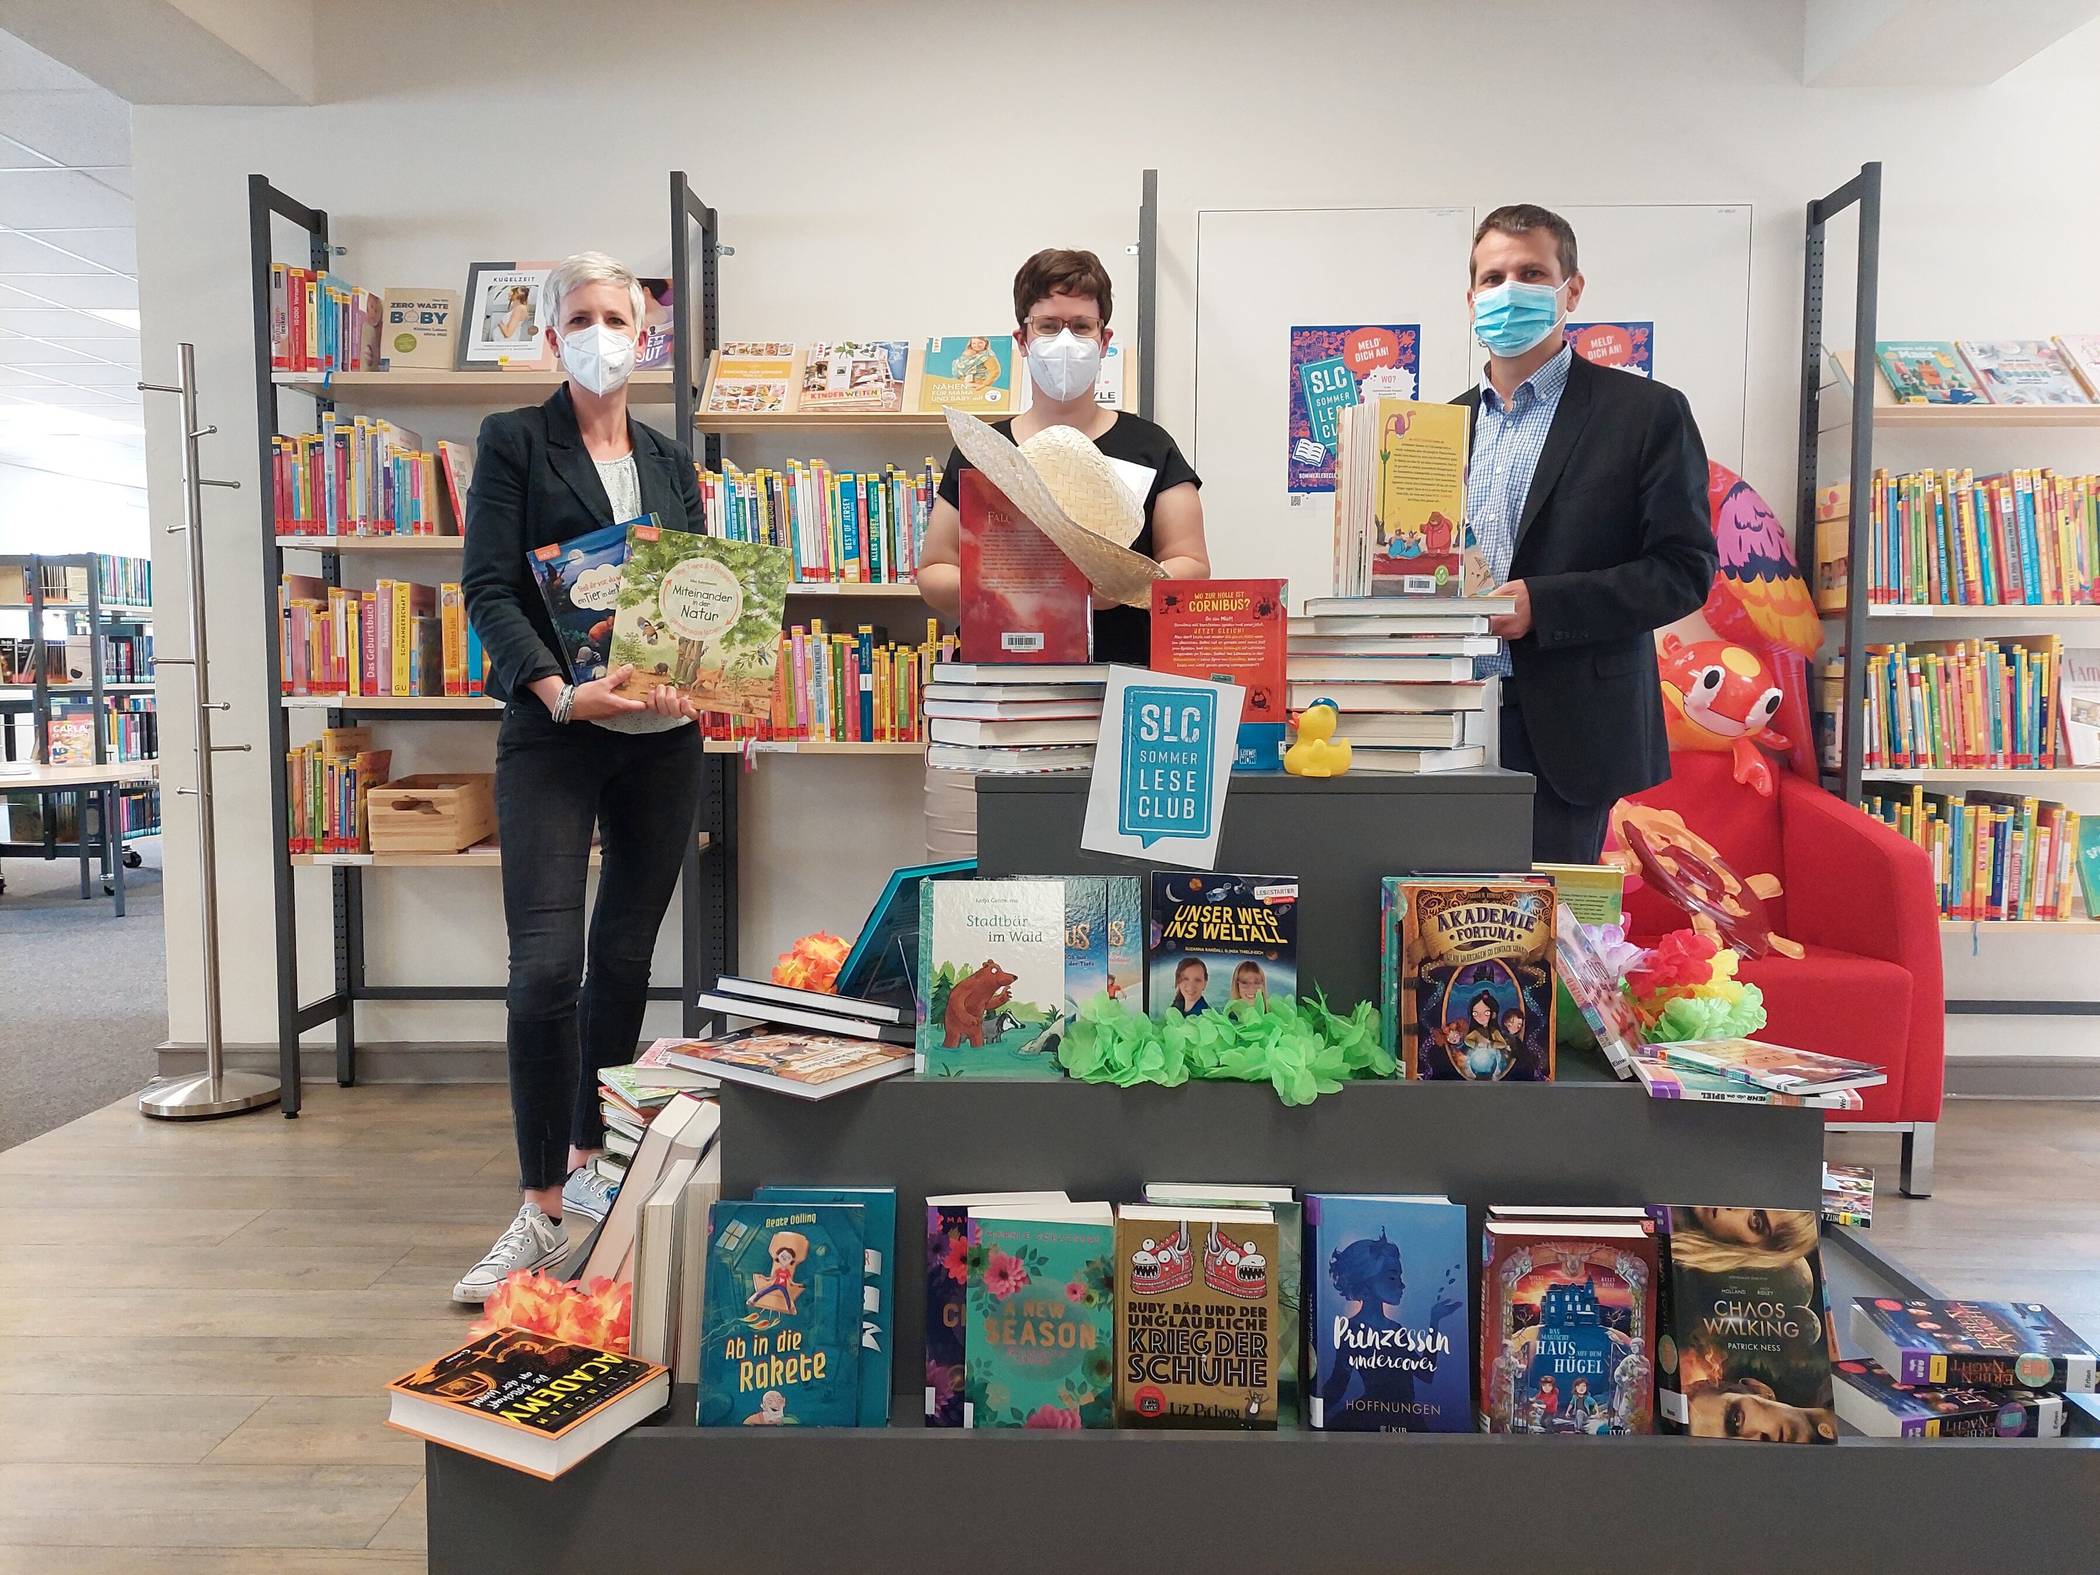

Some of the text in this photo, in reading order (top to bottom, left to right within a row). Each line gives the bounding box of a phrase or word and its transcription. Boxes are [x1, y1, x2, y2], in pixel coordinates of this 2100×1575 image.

[417, 302, 449, 310] WASTE
[390, 311, 449, 324] BBY
[1355, 346, 1390, 362] DICH AN!
[1587, 344, 1623, 361] DICH AN!
[1310, 366, 1348, 395] SLC
[1381, 375, 1397, 384] WO?
[1316, 392, 1351, 407] SOMMER
[843, 497, 852, 551] BEST OF JERSEY
[584, 590, 601, 602] Tier
[673, 585, 733, 603] Miteinander
[1236, 591, 1245, 599] IST
[681, 605, 719, 621] Natur
[1189, 598, 1251, 612] CORNIBUS?
[366, 603, 375, 678] Das Geburtsbuch
[1140, 704, 1200, 742] SLC
[1140, 750, 1198, 765] SOMMER
[1139, 769, 1197, 792] LESE
[1138, 796, 1195, 819] CLUB
[966, 914, 1029, 927] Stadtbär
[1175, 905, 1278, 926] UNSER WEG
[1437, 906, 1538, 933] AKADEMIE
[988, 931, 1043, 943] im Wald
[1163, 921, 1289, 944] INS WELTALL
[1456, 926, 1515, 941] FORTUNA
[1700, 1092, 1726, 1100] SPIEL
[765, 1216, 789, 1229] Beate
[1003, 1300, 1065, 1318] A NEW
[1128, 1301, 1267, 1317] RUBY, BÄR UND DER
[1714, 1300, 1786, 1319] CHAOS
[1128, 1315, 1267, 1331] UNGLAUBLICHE
[1703, 1317, 1800, 1338] WALKING
[984, 1318, 1097, 1350] SEASON
[1128, 1328, 1268, 1358] KRIEG DER
[1333, 1315, 1450, 1355] Prinzessin
[725, 1330, 802, 1361] Ab in die
[1535, 1341, 1576, 1355] HAUS
[1727, 1342, 1781, 1352] PATRICK NESS
[1349, 1350, 1437, 1372] undercover
[1554, 1356, 1604, 1374] HÜGEL
[739, 1351, 827, 1392] Rakete
[1128, 1354, 1267, 1388] SCHUHE
[499, 1353, 624, 1423] ACADEMY
[1346, 1400, 1441, 1416] HOFFNUNGEN
